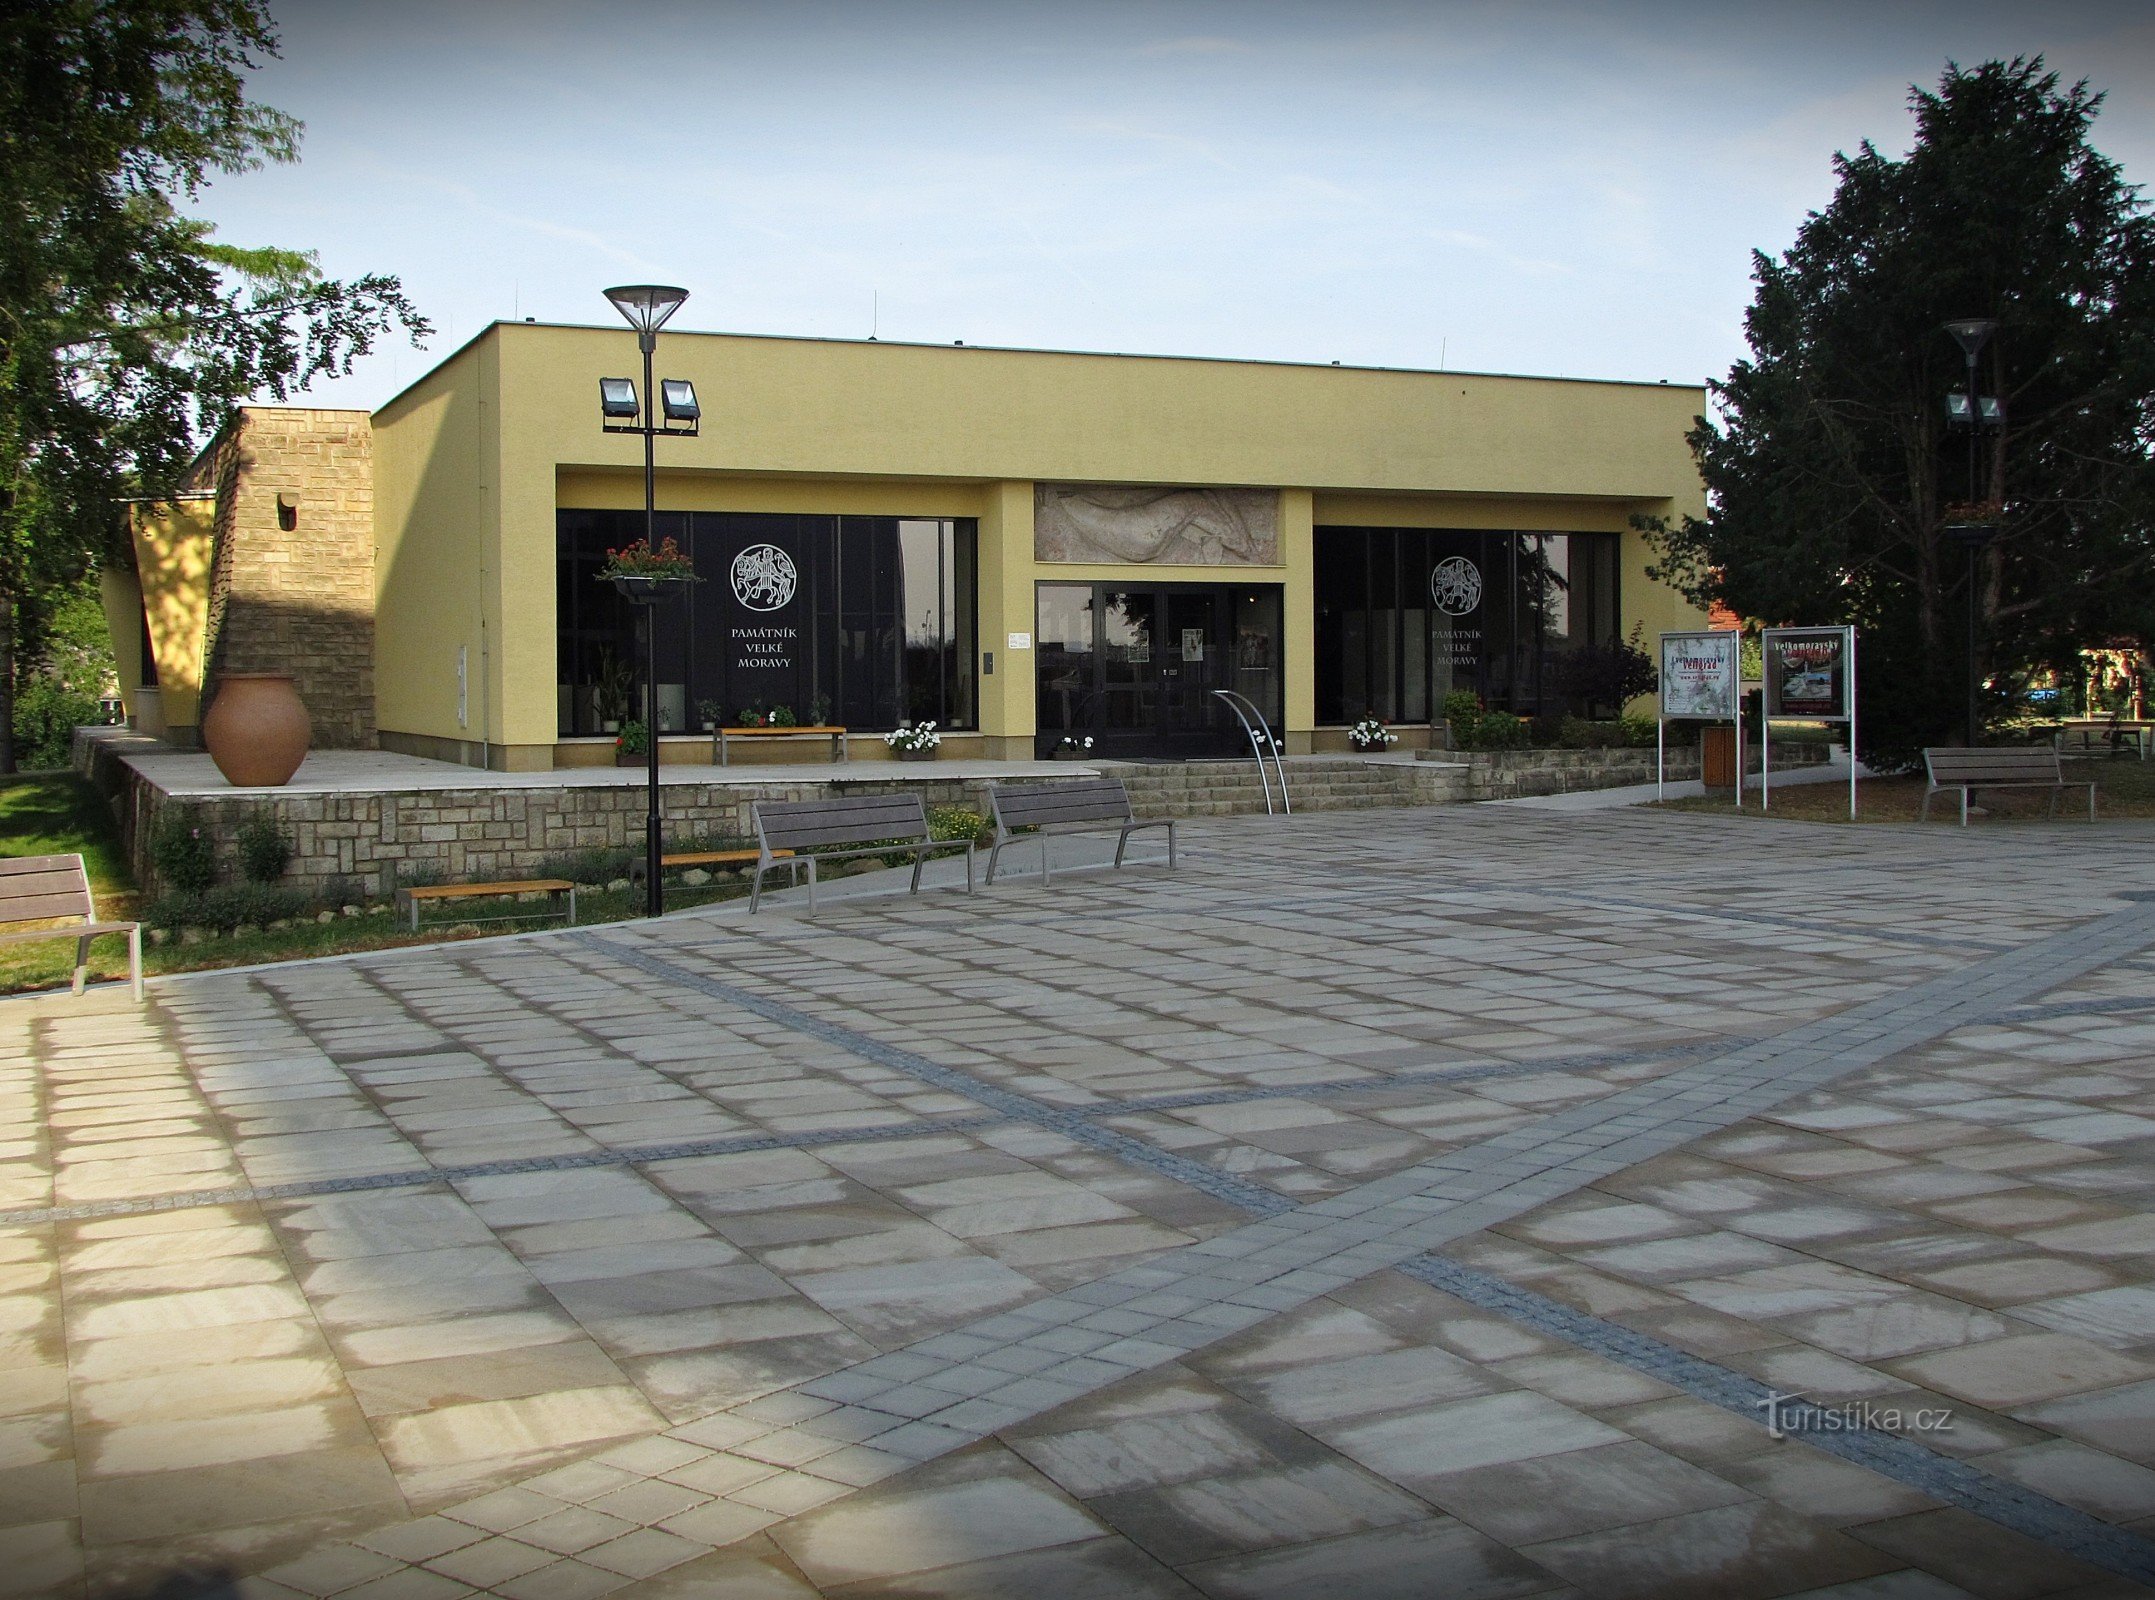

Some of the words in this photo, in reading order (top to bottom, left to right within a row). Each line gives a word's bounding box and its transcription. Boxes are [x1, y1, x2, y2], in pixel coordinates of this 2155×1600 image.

[731, 626, 798, 638] PAMÁTNÍK
[1431, 628, 1482, 639] PAMÁTNÍK
[745, 641, 784, 653] VELKÉ
[1442, 642, 1472, 652] VELKÉ
[737, 658, 791, 668] MORAVY
[1437, 656, 1478, 665] MORAVY
